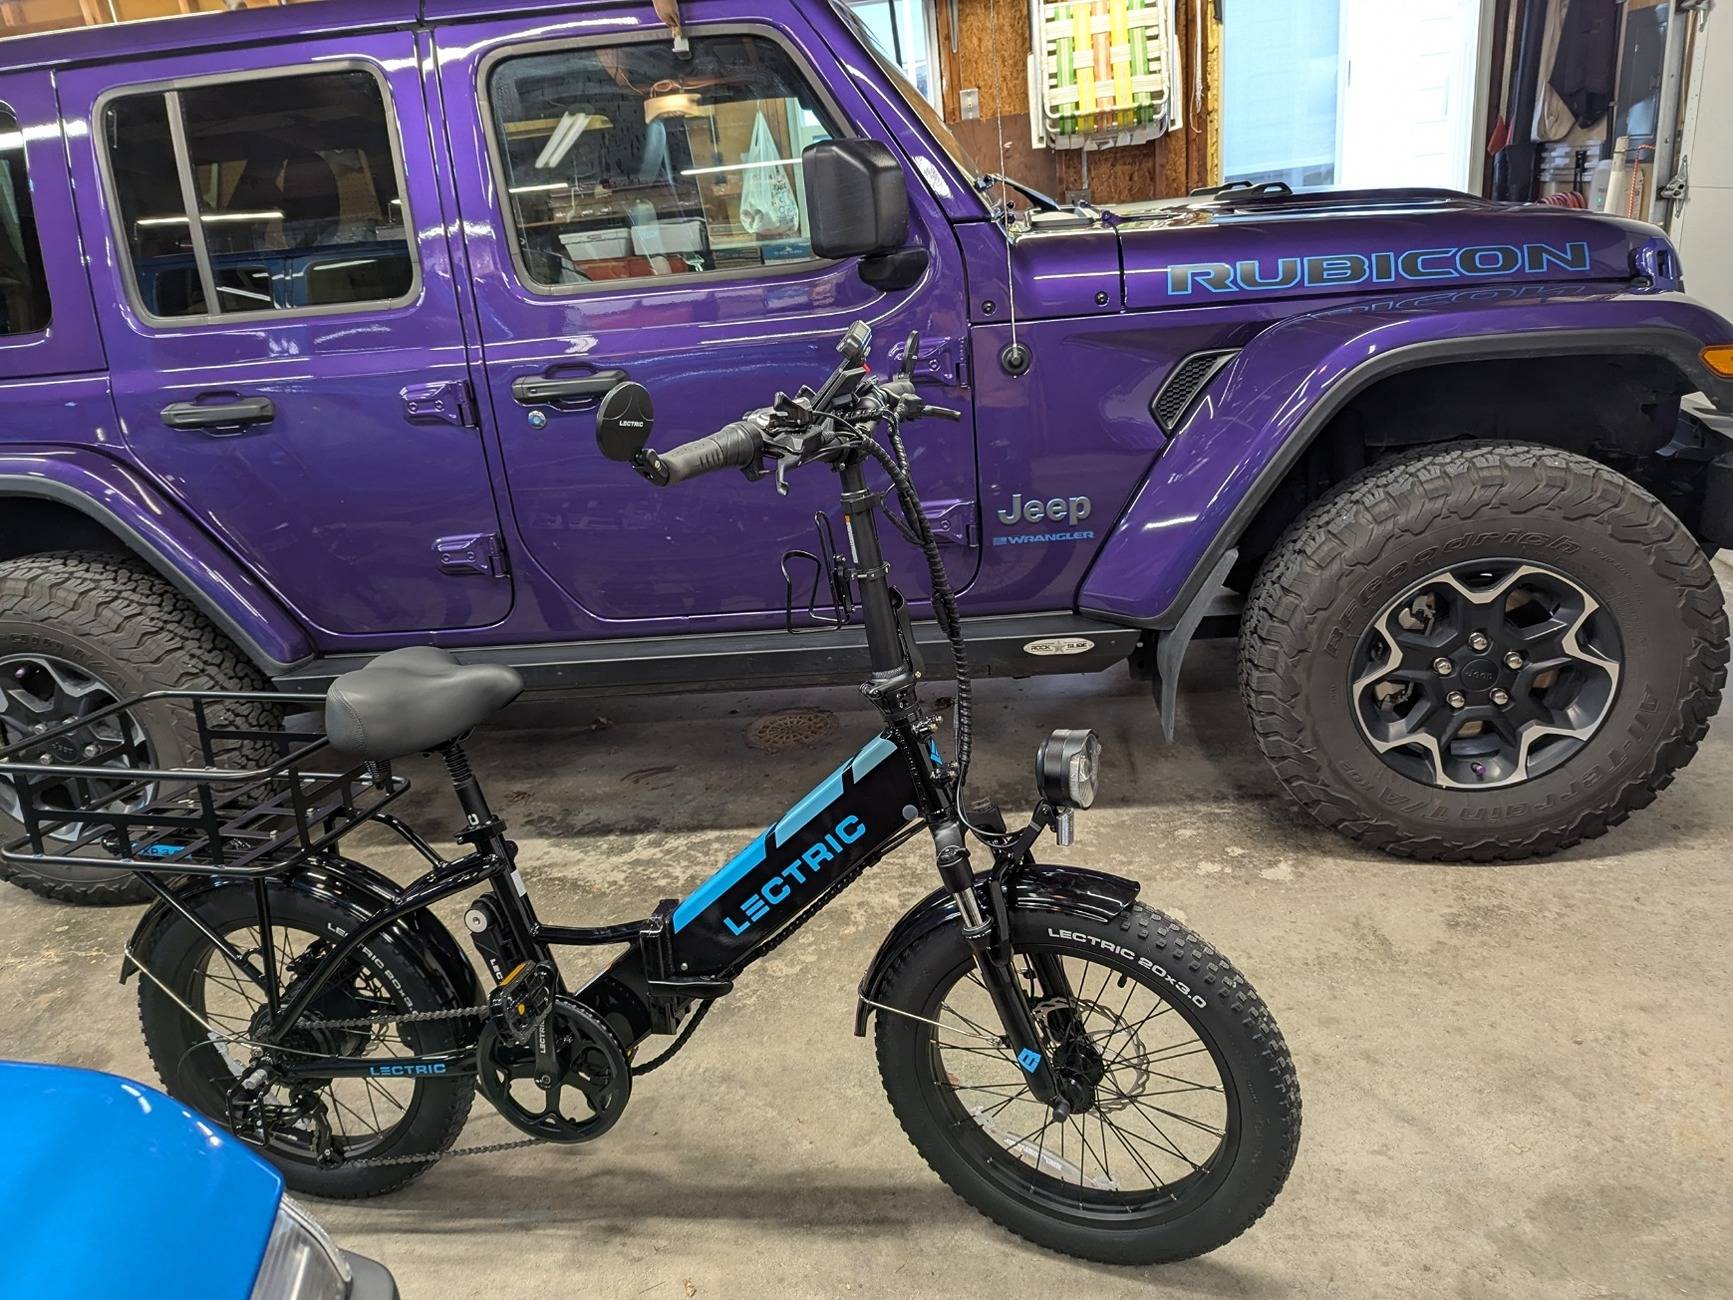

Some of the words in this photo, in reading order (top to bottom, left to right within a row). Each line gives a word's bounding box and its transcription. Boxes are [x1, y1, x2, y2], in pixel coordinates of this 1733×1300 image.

[1167, 242, 1590, 295] RUBICON
[619, 420, 644, 428] LECTRIC
[997, 493, 1092, 526] Jeep
[1007, 531, 1094, 545] WRANGLER
[1323, 528, 1582, 658] BFGoodrich
[723, 814, 867, 936] LECTRIC
[1048, 928, 1135, 960] LECTRIC
[1138, 957, 1207, 1009] 20x3.0
[370, 1063, 447, 1076] LECTRIC
